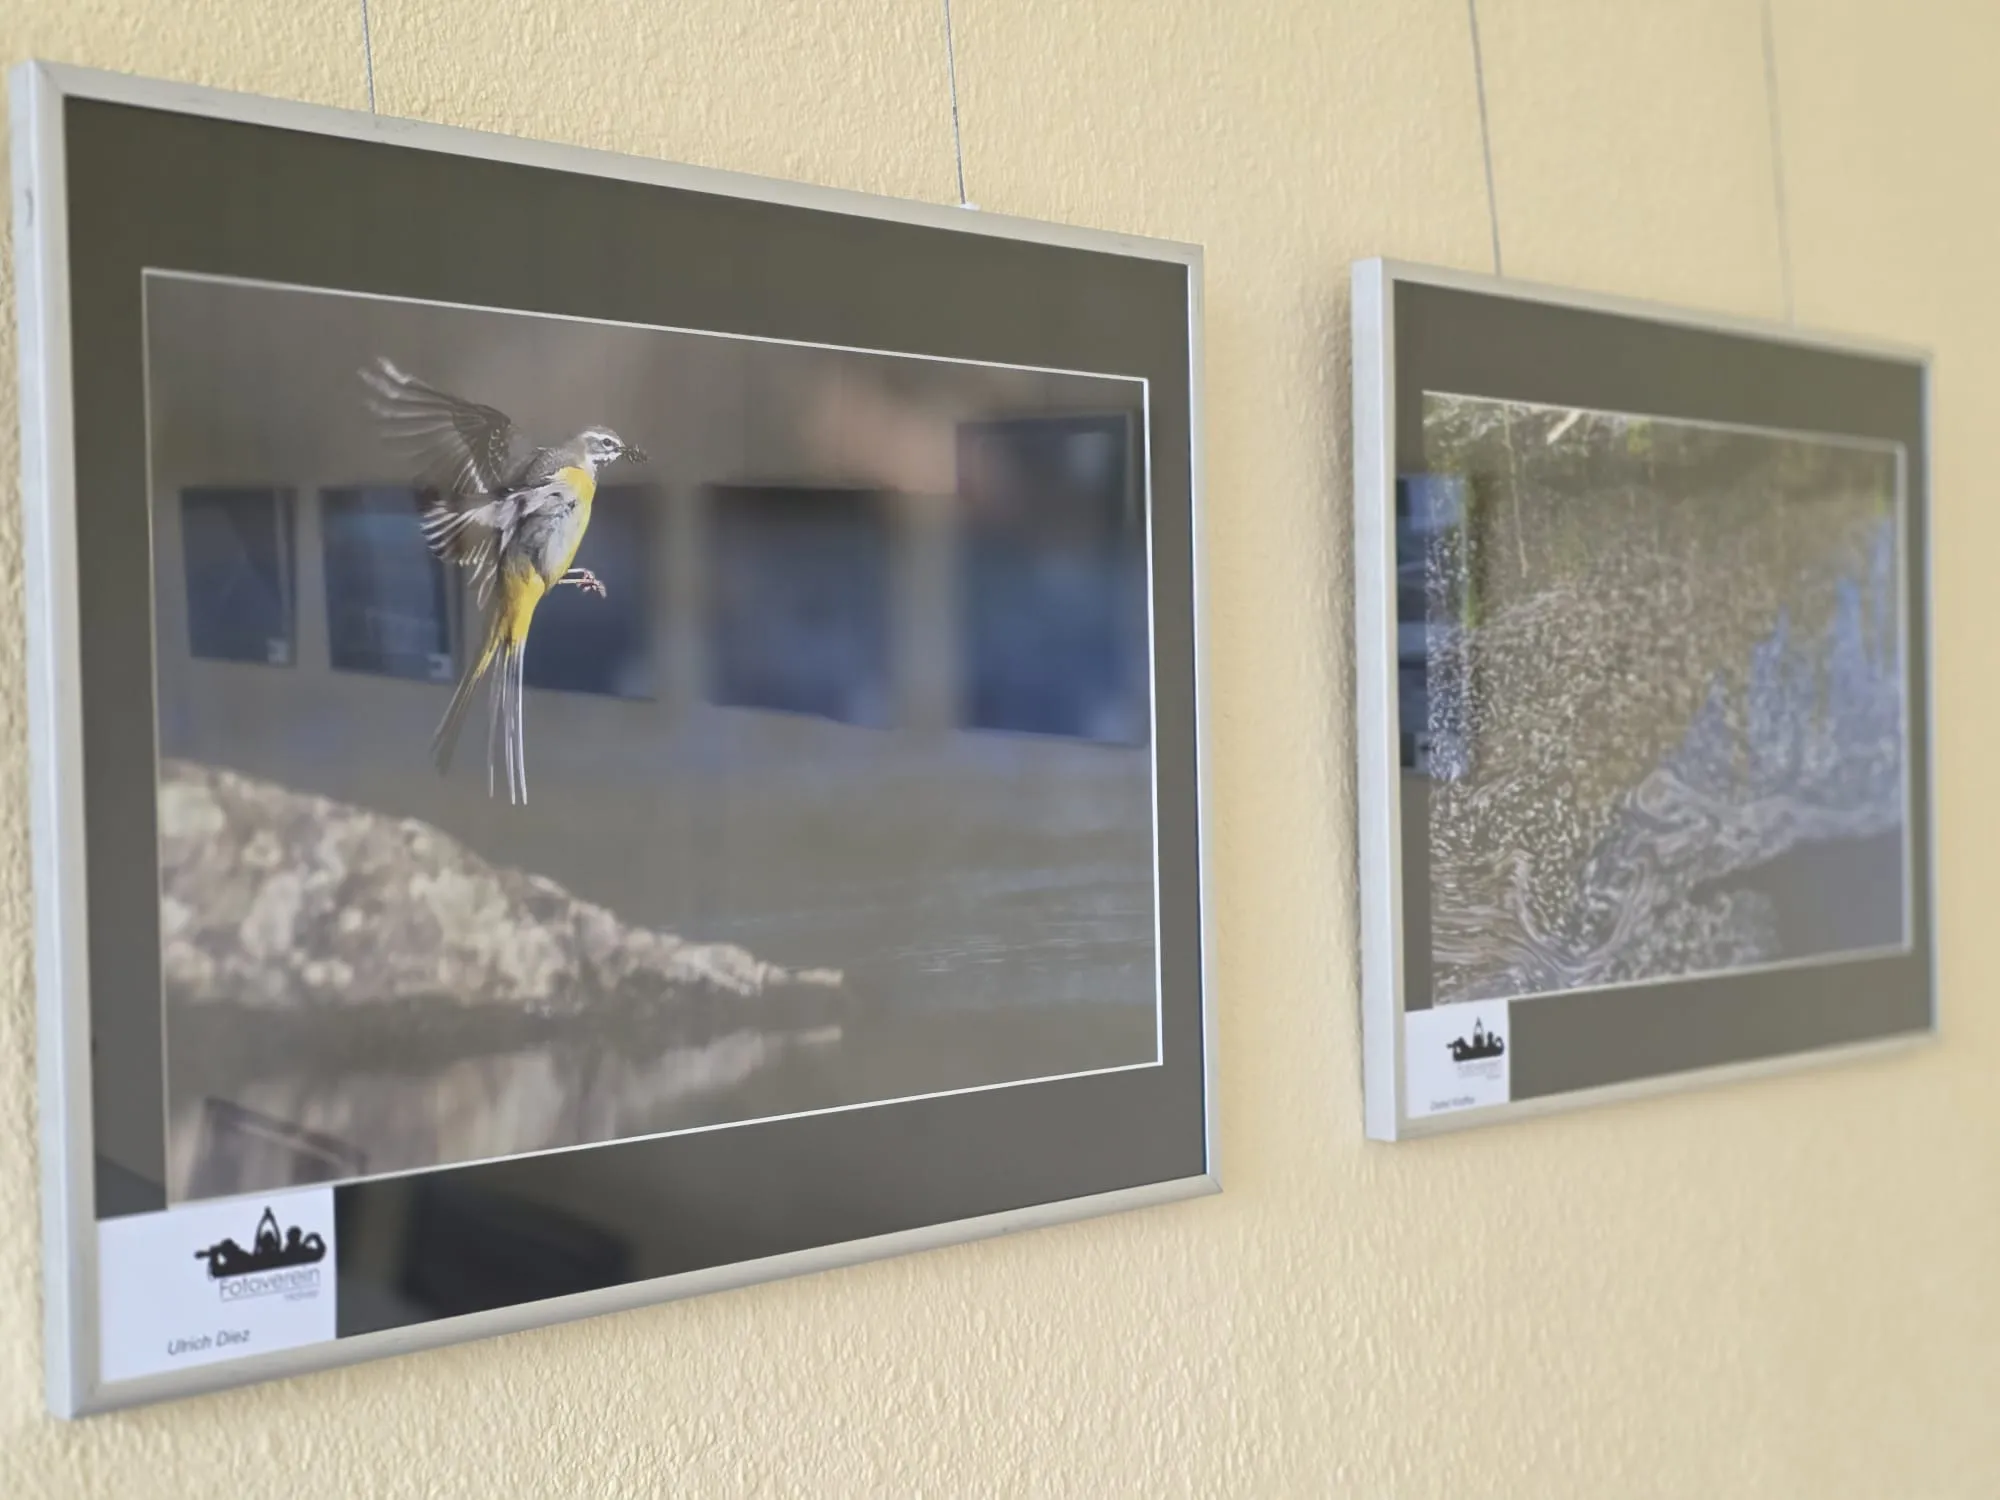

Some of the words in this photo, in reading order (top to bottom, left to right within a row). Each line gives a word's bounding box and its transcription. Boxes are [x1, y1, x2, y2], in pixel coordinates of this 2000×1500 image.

[219, 1267, 320, 1299] Fotoverein
[168, 1335, 212, 1356] Ulrich
[215, 1330, 250, 1348] Diez
